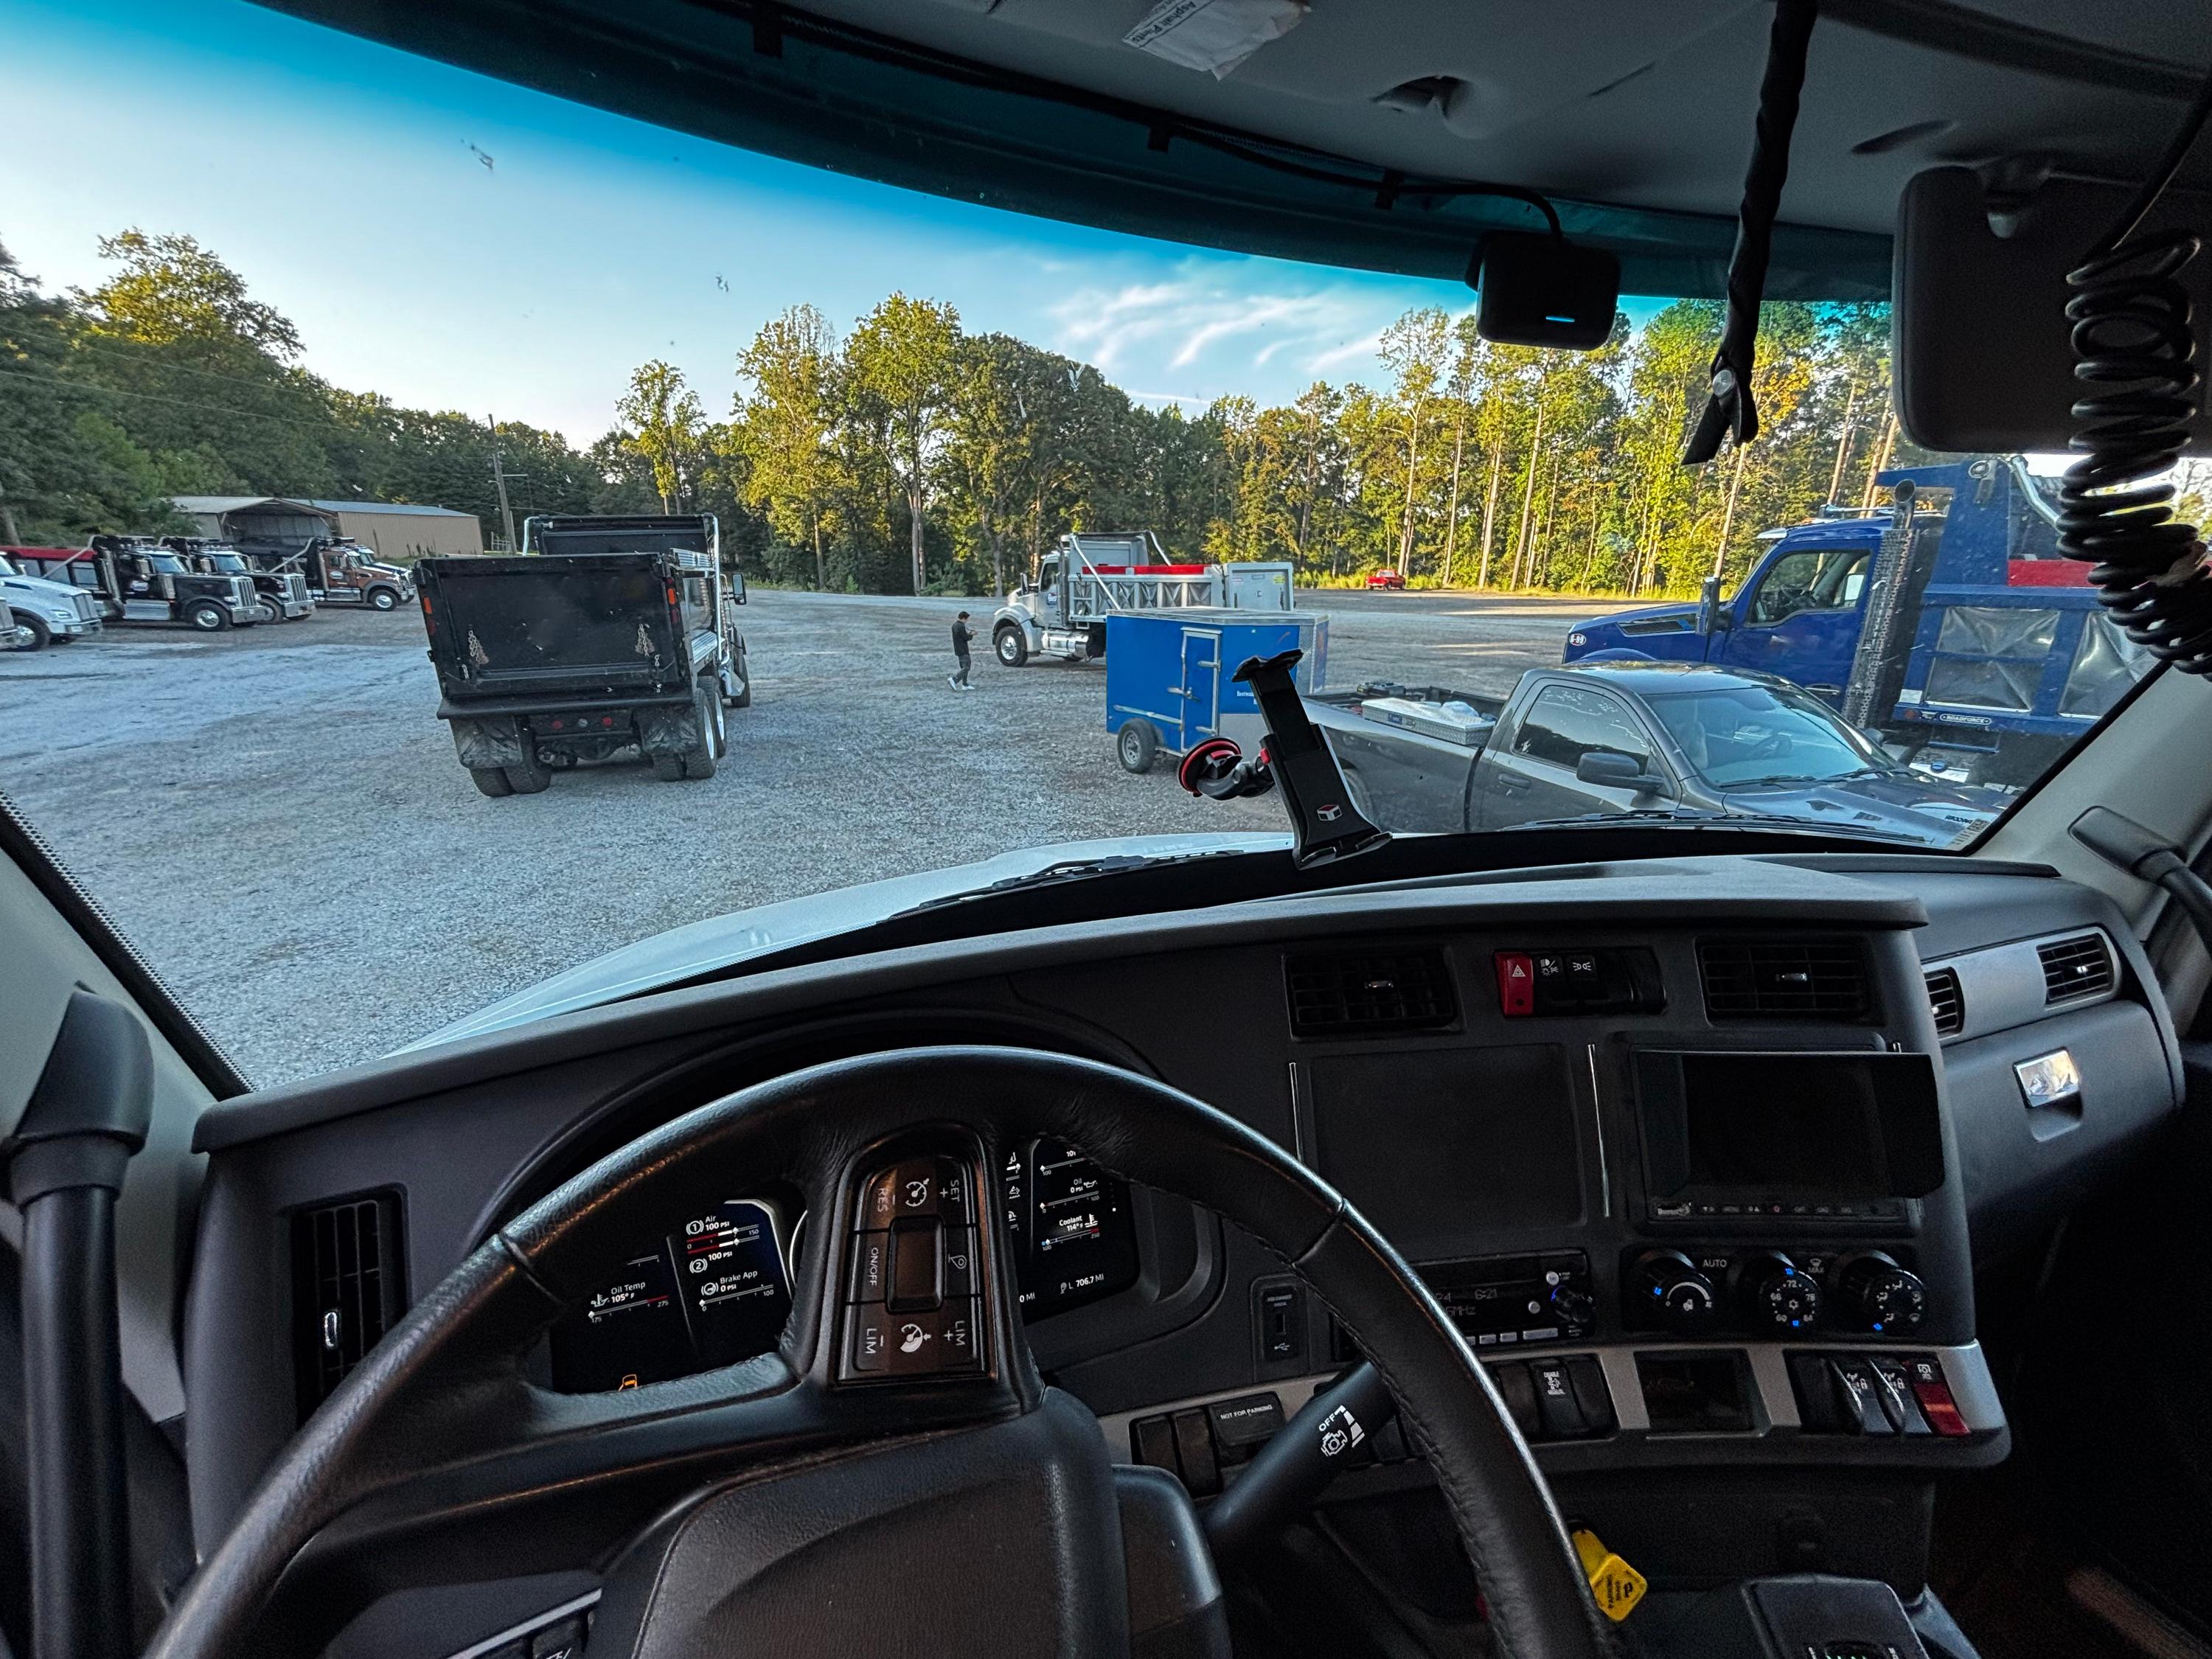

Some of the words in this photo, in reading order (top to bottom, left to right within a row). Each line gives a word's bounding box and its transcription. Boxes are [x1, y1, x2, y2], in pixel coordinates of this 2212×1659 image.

[1074, 1178, 1082, 1186] Oil
[950, 1180, 960, 1203] SET
[877, 1188, 888, 1212] RES
[705, 1215, 717, 1223] Air
[1059, 1215, 1083, 1226] Coolant
[706, 1222, 720, 1231] 100
[708, 1252, 722, 1261] 100
[1702, 1258, 1728, 1269] AUTO
[870, 1247, 879, 1287] ON/OFF
[720, 1274, 741, 1284] Brake
[742, 1270, 758, 1279] App
[1076, 1276, 1094, 1287] 706.7
[1095, 1273, 1105, 1281] MI
[1787, 1279, 1797, 1288] 72
[611, 1286, 622, 1295] Oil
[624, 1281, 646, 1291] Temp
[1019, 1295, 1025, 1303] 0
[1026, 1292, 1036, 1301] MI
[1770, 1293, 1781, 1301] 66
[955, 1320, 966, 1346] LIM
[864, 1328, 877, 1354] LIM
[1220, 1412, 1233, 1420] NOT
[1247, 1404, 1273, 1415] PARKING
[1318, 1413, 1337, 1433] OFF
